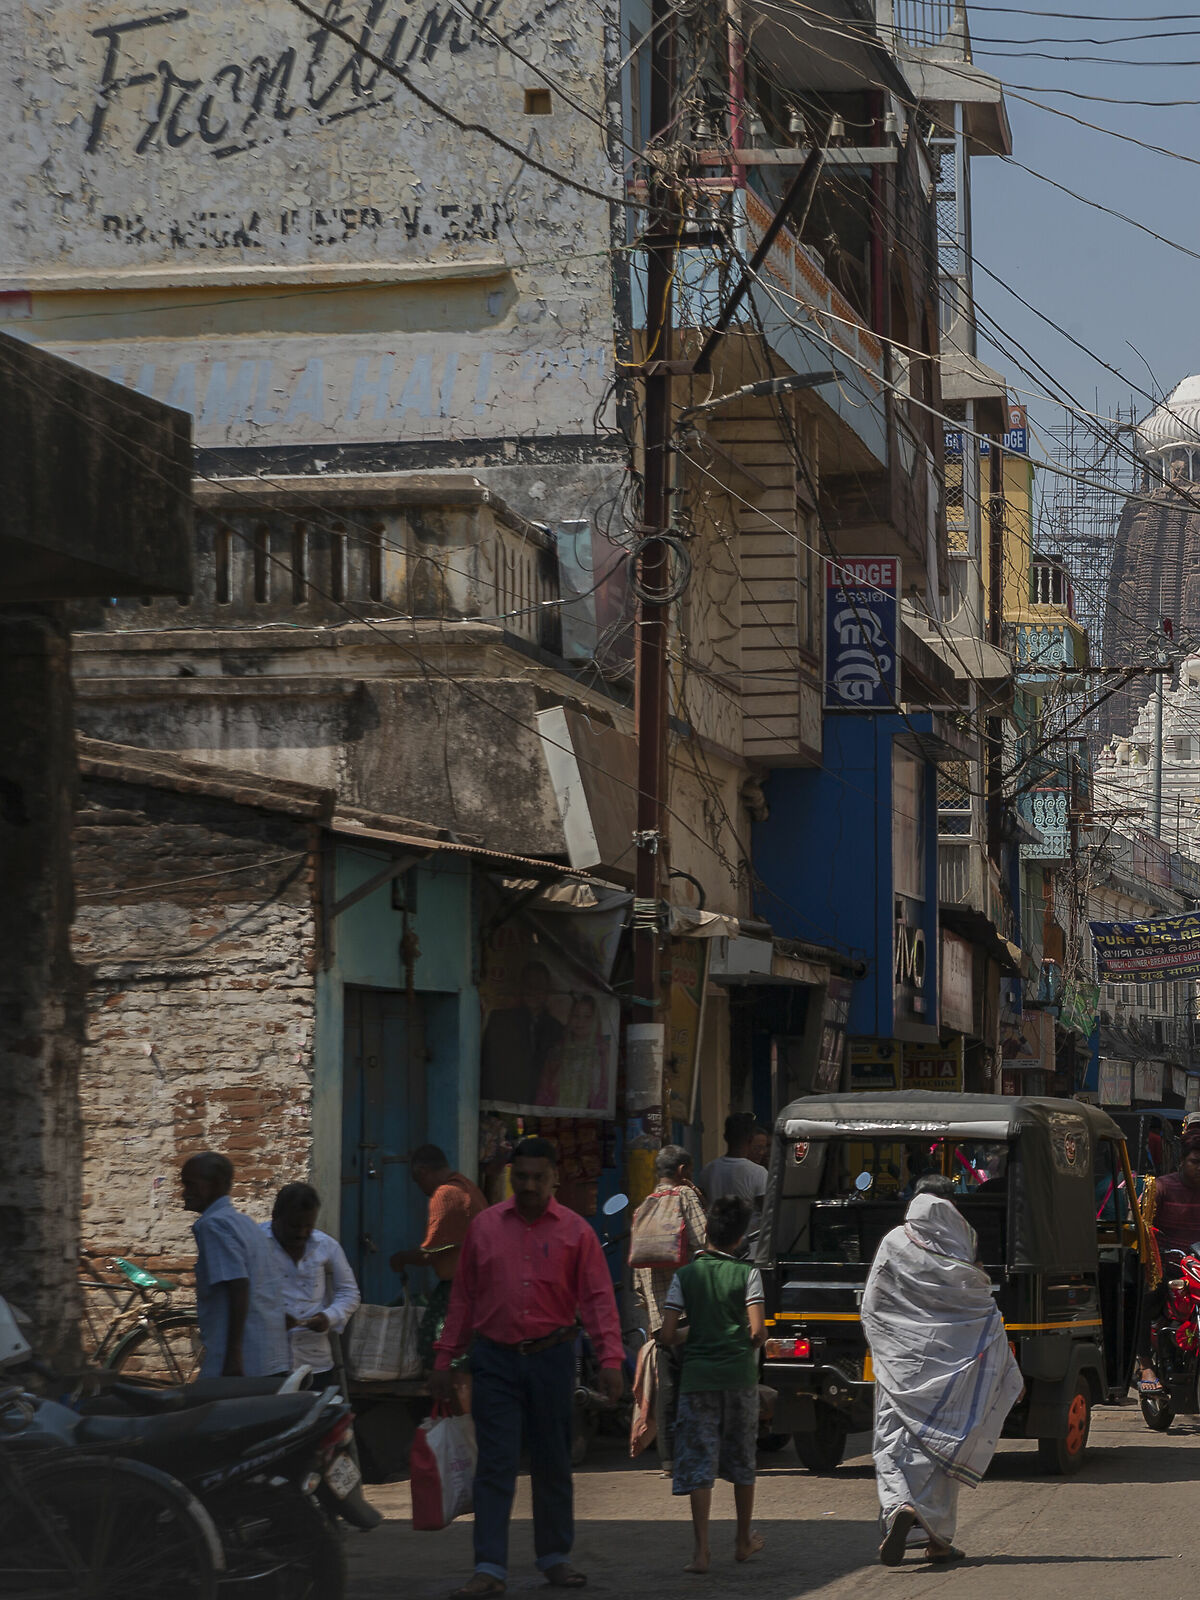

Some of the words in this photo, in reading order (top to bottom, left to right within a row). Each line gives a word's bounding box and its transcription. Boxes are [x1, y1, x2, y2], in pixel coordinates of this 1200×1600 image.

[831, 564, 892, 586] LODGE
[1095, 935, 1136, 945] PURE
[1139, 933, 1177, 945] VEG.
[903, 1061, 955, 1077] SHA
